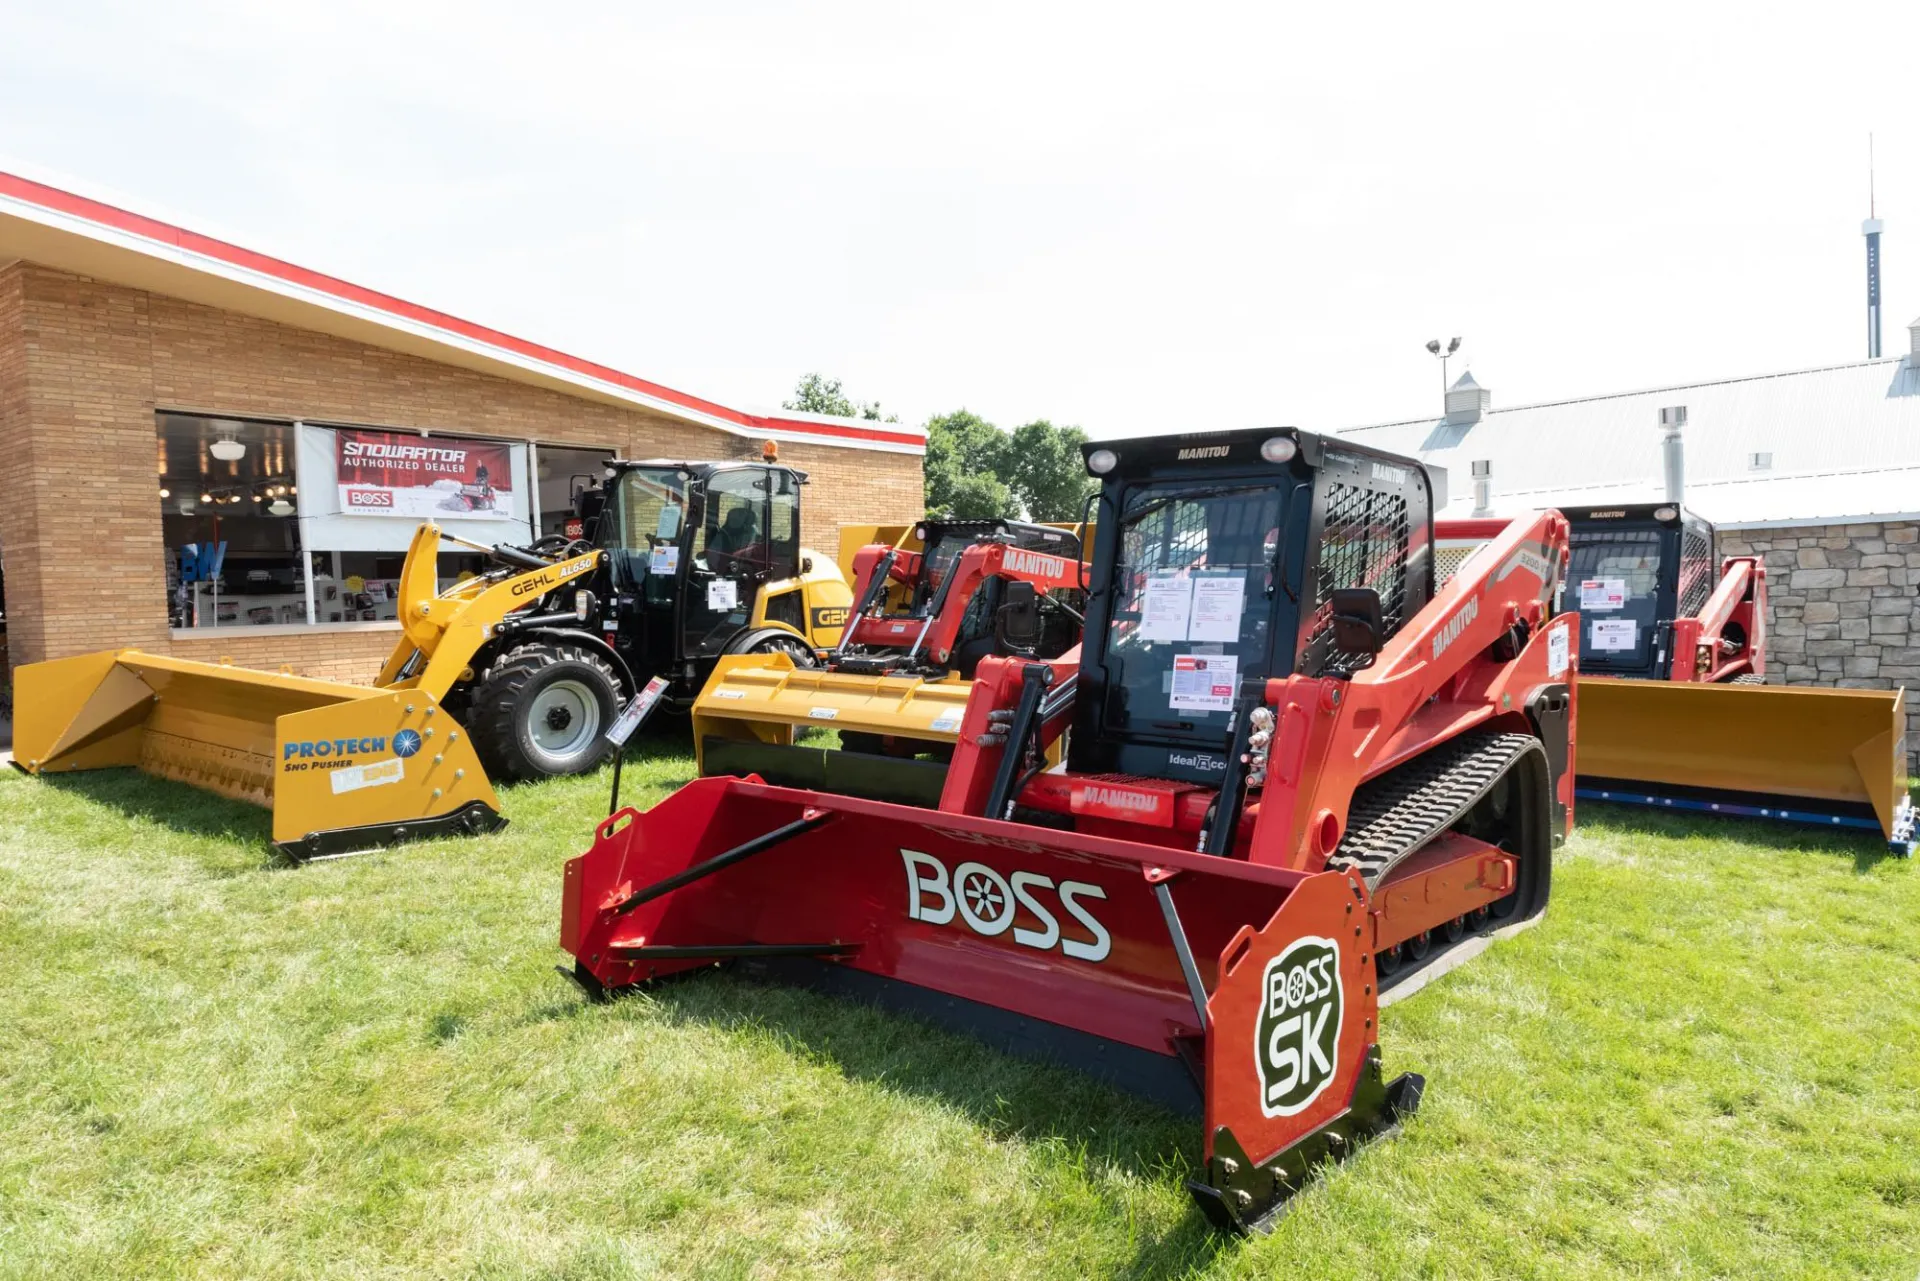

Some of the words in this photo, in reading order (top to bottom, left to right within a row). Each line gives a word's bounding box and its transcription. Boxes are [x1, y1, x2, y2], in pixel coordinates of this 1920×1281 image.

[343, 441, 467, 463] SNOWRATOR
[1178, 445, 1230, 460] MANITOU
[344, 457, 420, 470] AUTHORIZED
[425, 462, 466, 473] DEALER
[1371, 462, 1406, 485] MANITOU
[351, 491, 390, 506] BOSS
[559, 558, 593, 579] AL650
[1001, 550, 1066, 579] MANITOU
[511, 573, 556, 597] GEHL
[818, 609, 850, 626] GEH
[1432, 594, 1479, 661] MANITOU
[311, 759, 353, 770] PUSHER
[1083, 785, 1159, 813] MANITOU
[900, 848, 1112, 963] BOSS
[1269, 953, 1334, 1020] BOSS
[1268, 1001, 1333, 1103] SK
